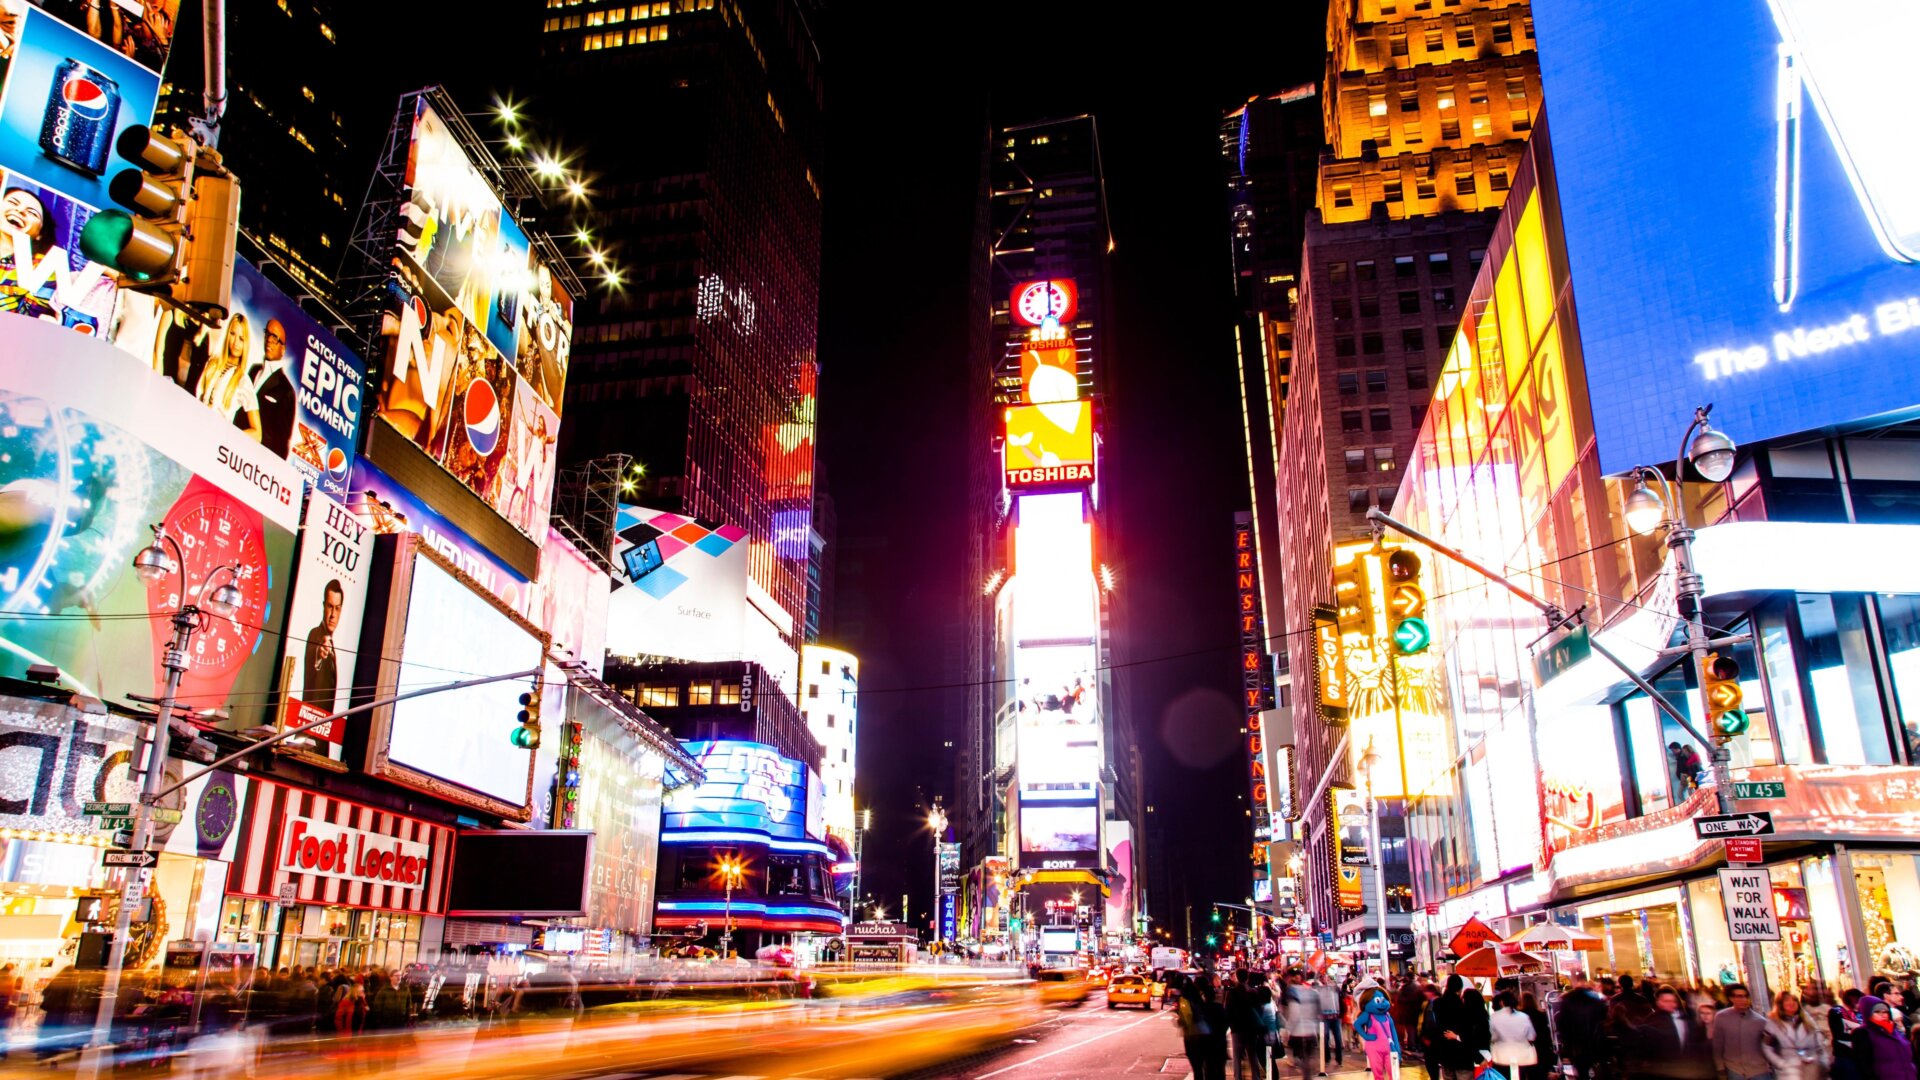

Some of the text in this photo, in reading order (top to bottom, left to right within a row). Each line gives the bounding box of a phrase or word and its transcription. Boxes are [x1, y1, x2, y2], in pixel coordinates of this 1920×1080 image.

[53, 106, 69, 148] pepsi
[1030, 324, 1067, 342] 2012
[1023, 338, 1074, 350] TOSHIBA
[1694, 344, 1768, 381] The
[1773, 313, 1871, 362] Next
[307, 334, 362, 385] CATCH EVERY
[301, 347, 360, 422] EPIC
[299, 386, 356, 440] MOMENT
[216, 444, 280, 500] swatch
[1006, 465, 1092, 484] TOSHIBA
[199, 517, 209, 534] 11
[218, 517, 231, 536] 12
[325, 502, 367, 546] HEY
[182, 531, 195, 549] 10
[321, 531, 361, 572] YOU
[677, 604, 712, 620] Surface
[195, 639, 206, 656] 6
[216, 637, 227, 653] 5
[1237, 530, 1267, 801] ERNST & YOUNG
[740, 662, 752, 713] 1500
[310, 723, 331, 738] 2012
[1737, 784, 1751, 799] W
[1755, 782, 1774, 799] 45
[86, 803, 130, 811] GEORGE ABBOTT
[101, 820, 113, 829] W
[112, 818, 127, 829] 45
[1705, 818, 1761, 833] ONE WAY
[1735, 838, 1759, 846] STANDING
[110, 854, 150, 864] ONE WAY
[284, 820, 427, 885] Foot Locker
[1043, 860, 1077, 869] SONY
[1730, 876, 1761, 889] WAIT
[1736, 891, 1762, 904] FOR
[1733, 907, 1770, 920] WALK
[854, 925, 897, 935] nuchas
[1465, 930, 1488, 939] ROAD
[1734, 922, 1774, 936] SIGNAL
[1523, 941, 1543, 952] NUTS
[1547, 940, 1569, 951] NUTS
